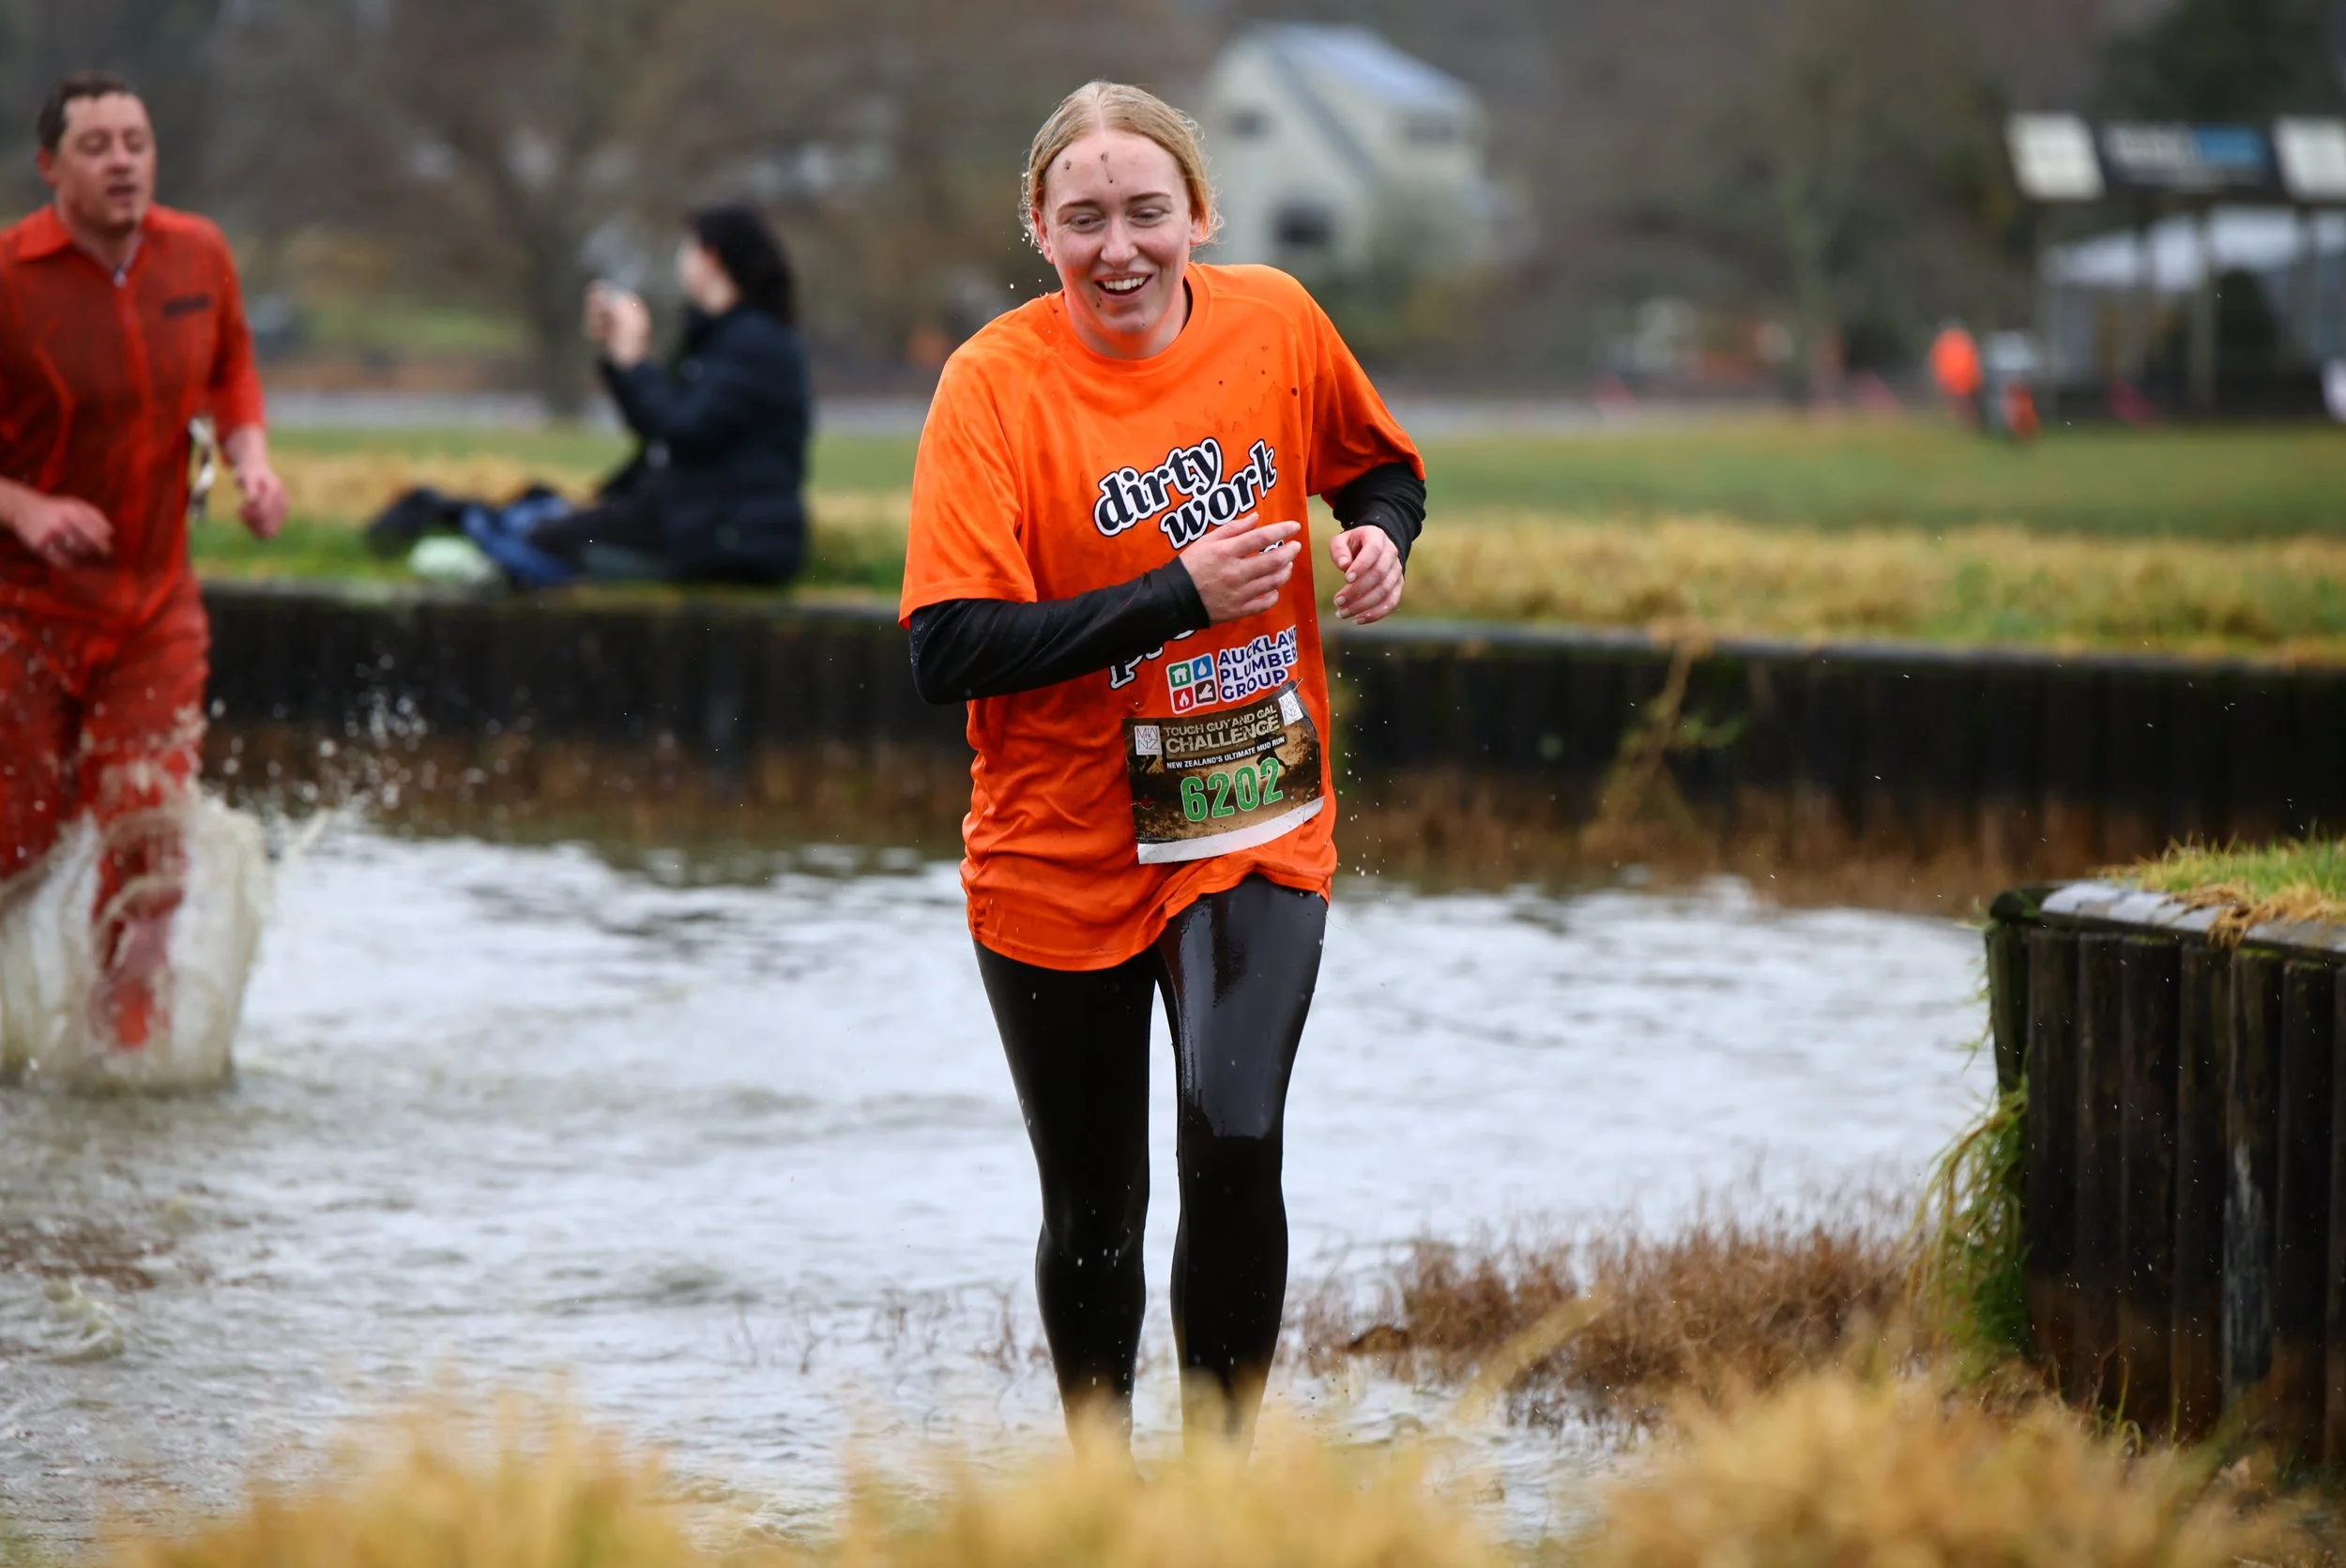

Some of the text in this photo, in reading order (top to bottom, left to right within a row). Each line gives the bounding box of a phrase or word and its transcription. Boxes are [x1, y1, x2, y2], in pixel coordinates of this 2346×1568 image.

[1095, 438, 1222, 535] dirty
[1160, 440, 1276, 548] work
[1221, 670, 1286, 699] GROUP
[1164, 705, 1276, 737] TOUGH GUY AND GAL
[1165, 714, 1280, 754] CHALLENGE
[1166, 736, 1285, 769] NEW ZEALAND'S ULTIMATE MUD RUN
[1180, 757, 1283, 822] 6202
